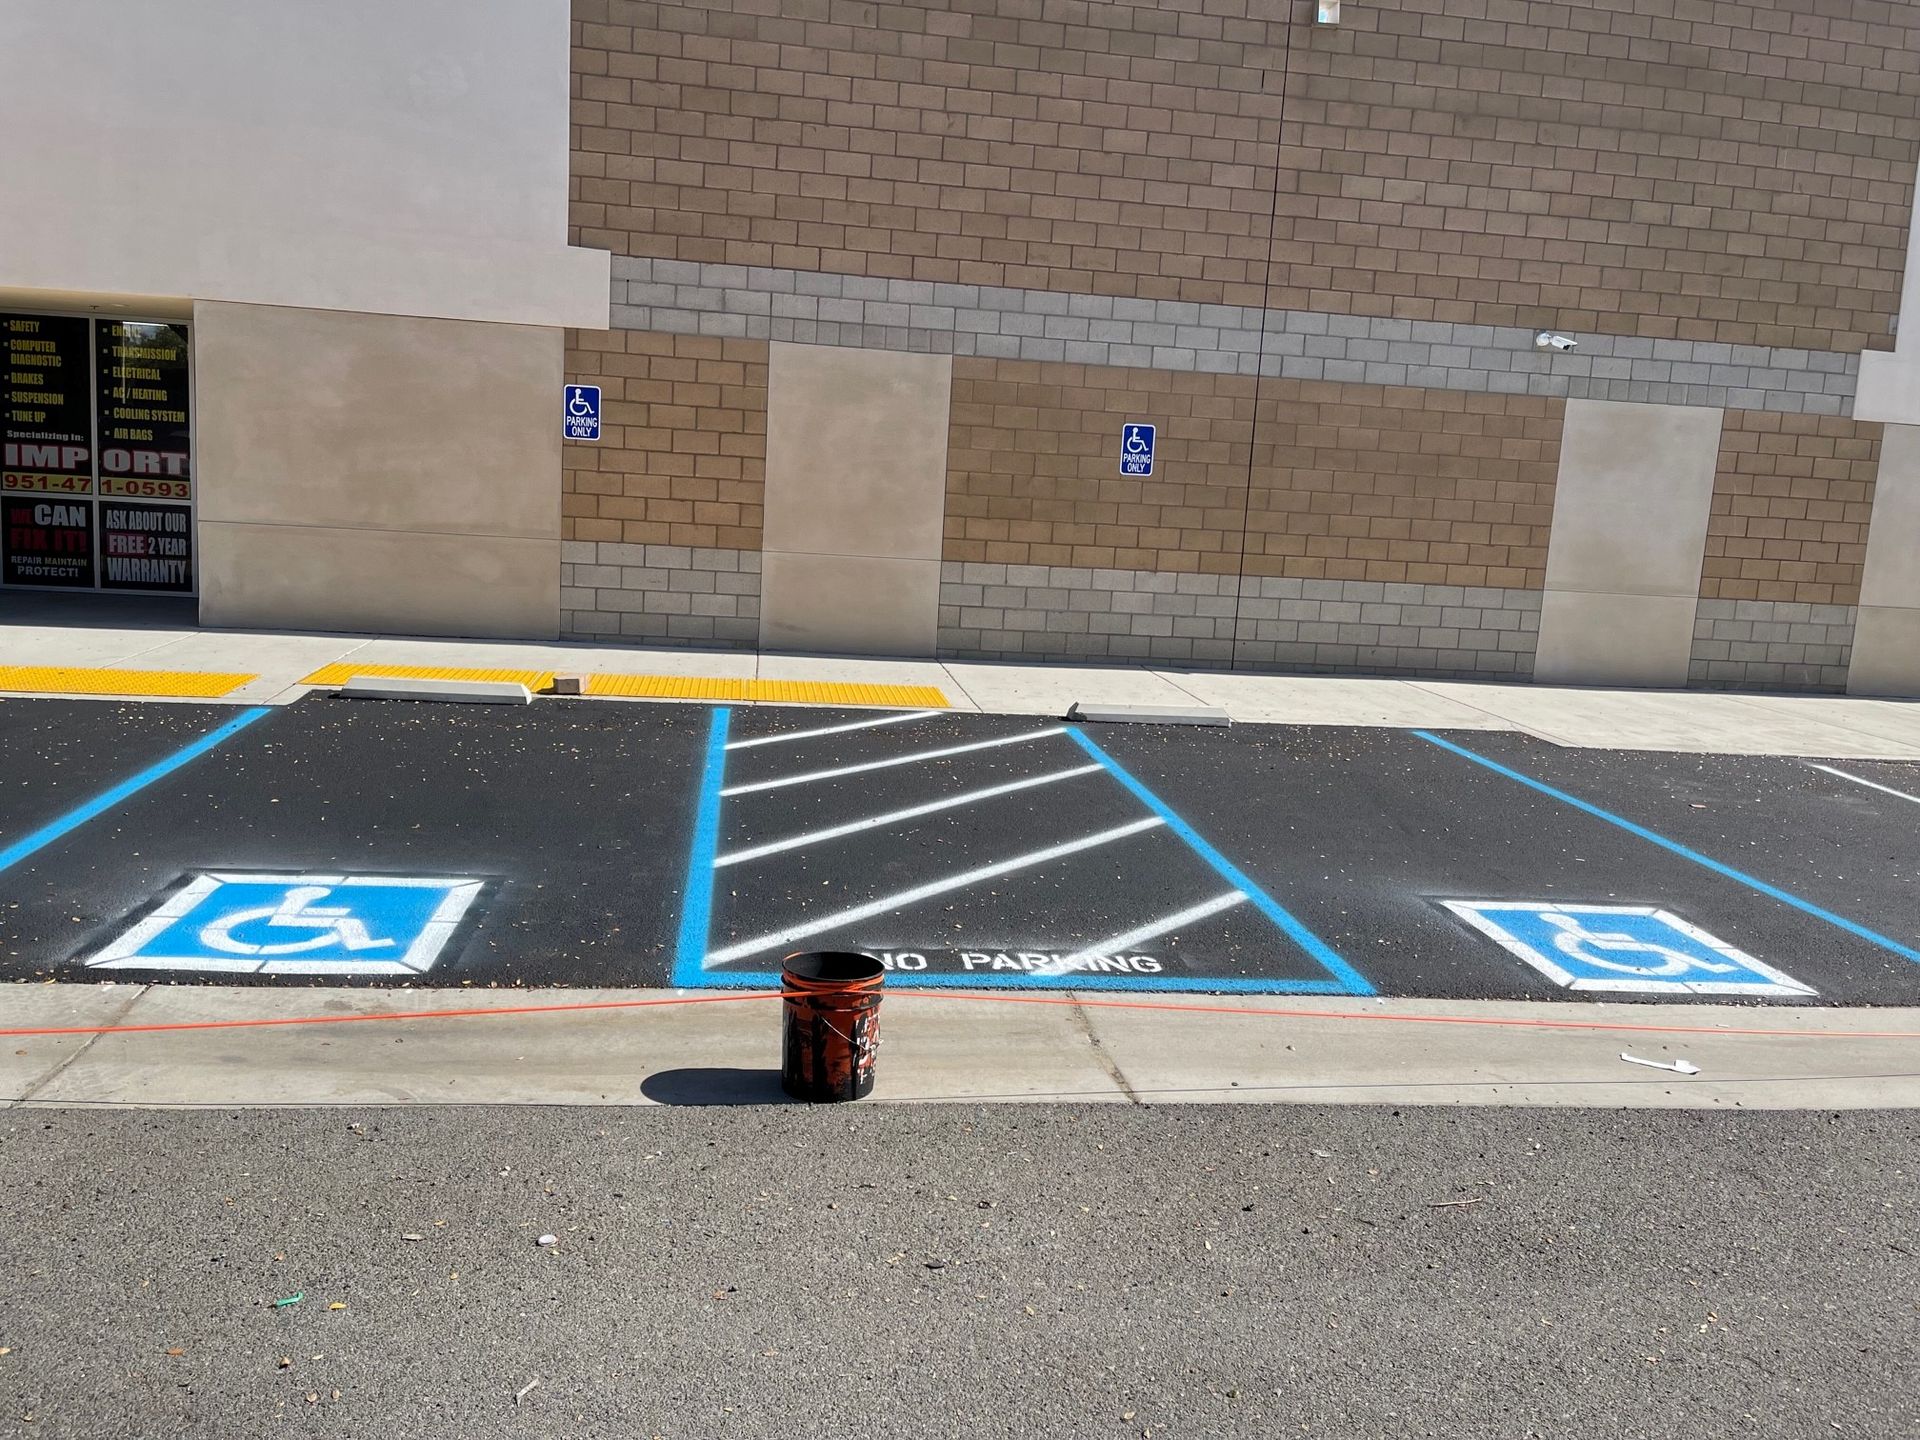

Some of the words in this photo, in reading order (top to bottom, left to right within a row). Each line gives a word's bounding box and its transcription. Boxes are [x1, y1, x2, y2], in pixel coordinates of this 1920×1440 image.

[10, 320, 39, 333] SAFETY
[10, 340, 56, 353] COMPUTER
[11, 353, 62, 367] DIAGNOSTIC
[112, 347, 177, 361] TRANSMISSION
[11, 373, 44, 385] BRAKES
[112, 368, 161, 381] ELECTRICAL
[12, 392, 64, 405] SUSPENSION
[132, 389, 168, 401] HEATING
[12, 410, 33, 422] TUNE
[34, 411, 46, 423] UP
[113, 407, 150, 420] COOLING
[152, 409, 185, 423] SYSTEM
[566, 416, 598, 428] PARKING
[7, 430, 69, 441] Specializing
[114, 428, 129, 439] AIR
[130, 428, 153, 441] BAGS
[571, 426, 592, 437] ONLY
[1123, 453, 1151, 464] PARKING
[1127, 463, 1146, 473] ONLY
[34, 504, 86, 527] CAN
[106, 509, 127, 530] ASK
[129, 511, 163, 531] ABOUT
[165, 513, 186, 533] OUR
[109, 534, 144, 554] FREE
[148, 537, 156, 554] 2
[158, 538, 186, 556] YEAR
[11, 556, 42, 565] REPAIR
[44, 557, 87, 567] MAINTAIN
[17, 566, 79, 577] PROTECT!
[107, 557, 187, 584] WARRANTY
[961, 952, 1163, 973] PARKING
